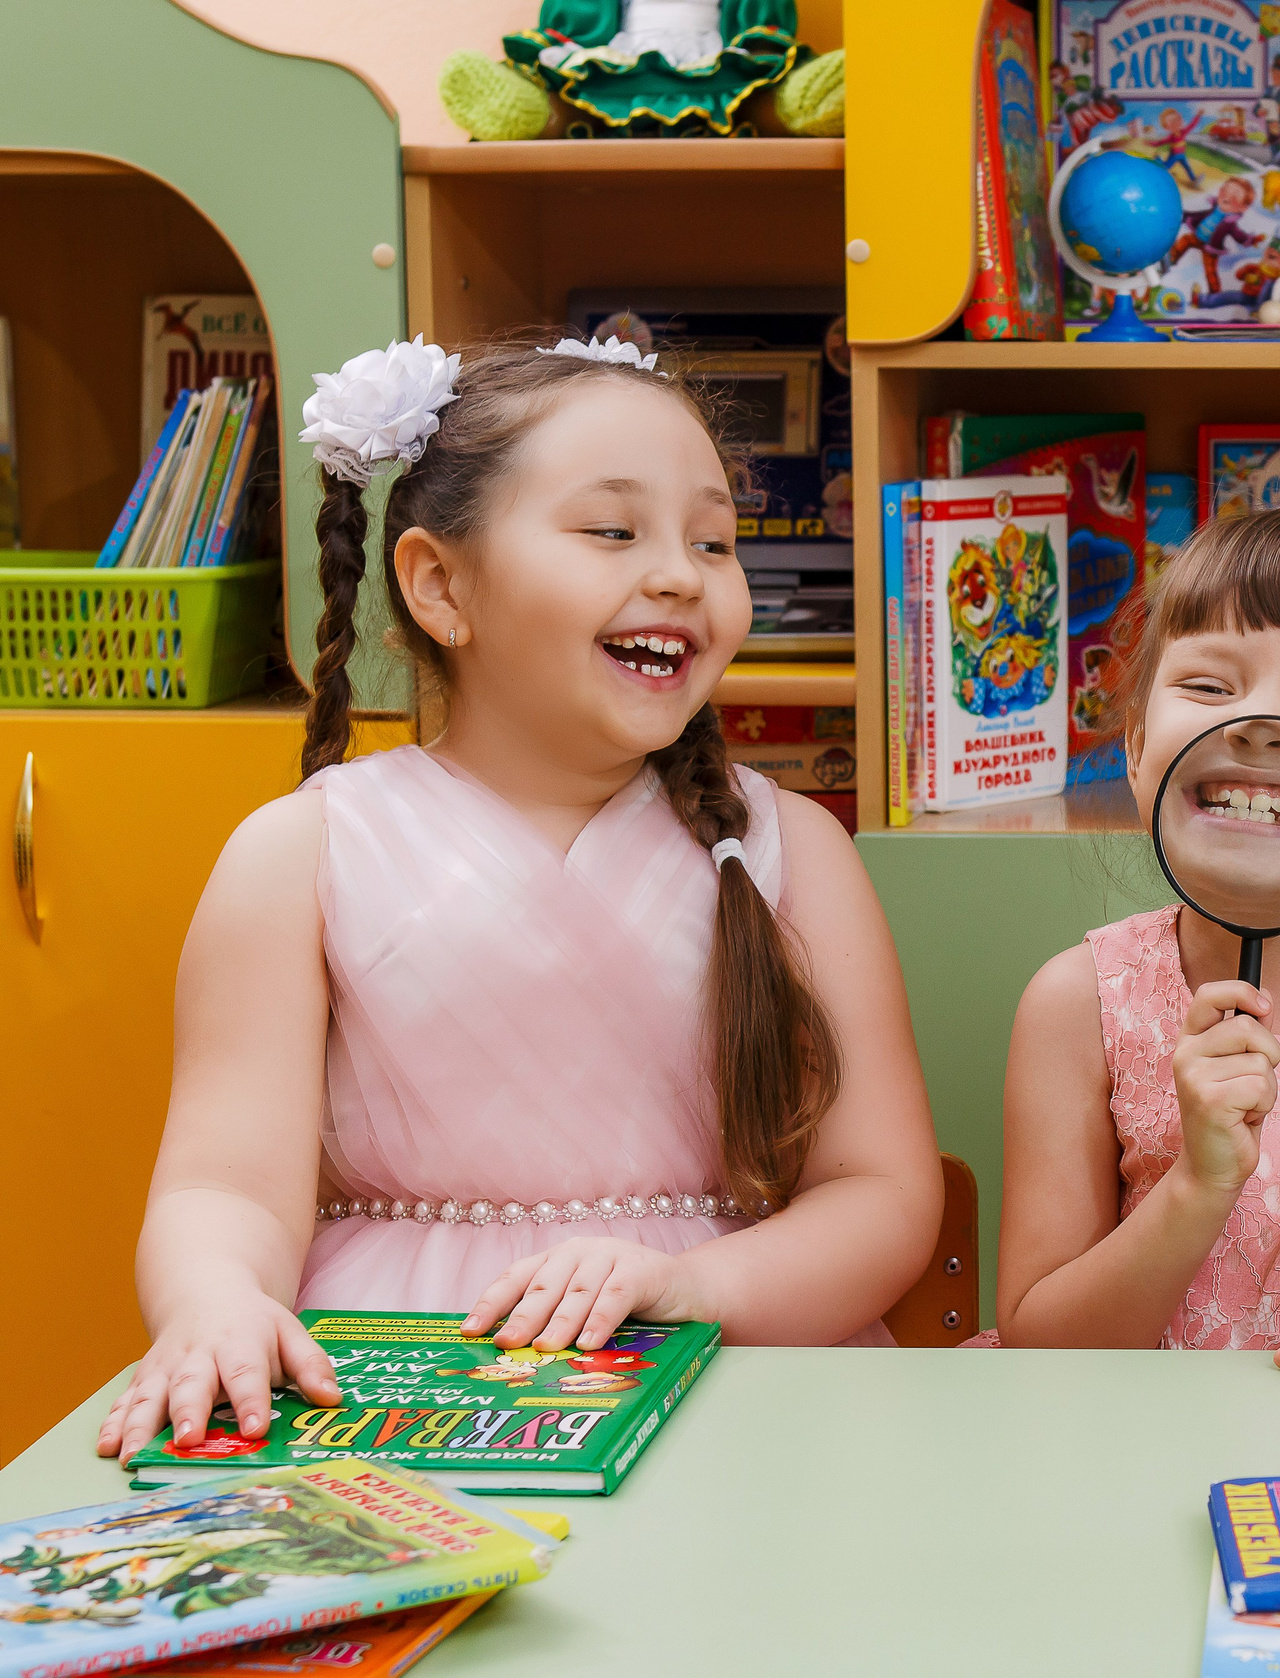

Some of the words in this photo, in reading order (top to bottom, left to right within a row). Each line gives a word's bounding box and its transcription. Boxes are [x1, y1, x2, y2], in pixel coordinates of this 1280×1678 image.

[1109, 41, 1254, 90] РАССКАЗЫ
[924, 536, 935, 594] ГОРОДА
[925, 600, 936, 704] ИЗУМРУДНОГО
[926, 710, 937, 800] ВОЛШЕБНИК
[953, 748, 1057, 775] ИЗУМРУДНОГО
[964, 731, 1046, 754] ВОЛШЕБНИК
[977, 771, 1033, 791] ГОРОДА
[311, 1334, 431, 1342] ТРАДИЦИОННОЙ
[363, 1362, 438, 1373] АМ
[663, 1357, 702, 1414] БУКВАРЬ
[354, 1395, 496, 1406] МА-МА
[284, 1408, 614, 1450] БУКВАРЬ
[291, 1449, 424, 1461] ЖУКОВА
[425, 1451, 561, 1462] Надежда
[302, 1472, 417, 1525] ГОРЫНЫЧ
[404, 1522, 477, 1553] ЗМЕЙ
[353, 1472, 469, 1527] ВАСИЛИСА
[463, 1525, 495, 1538] И
